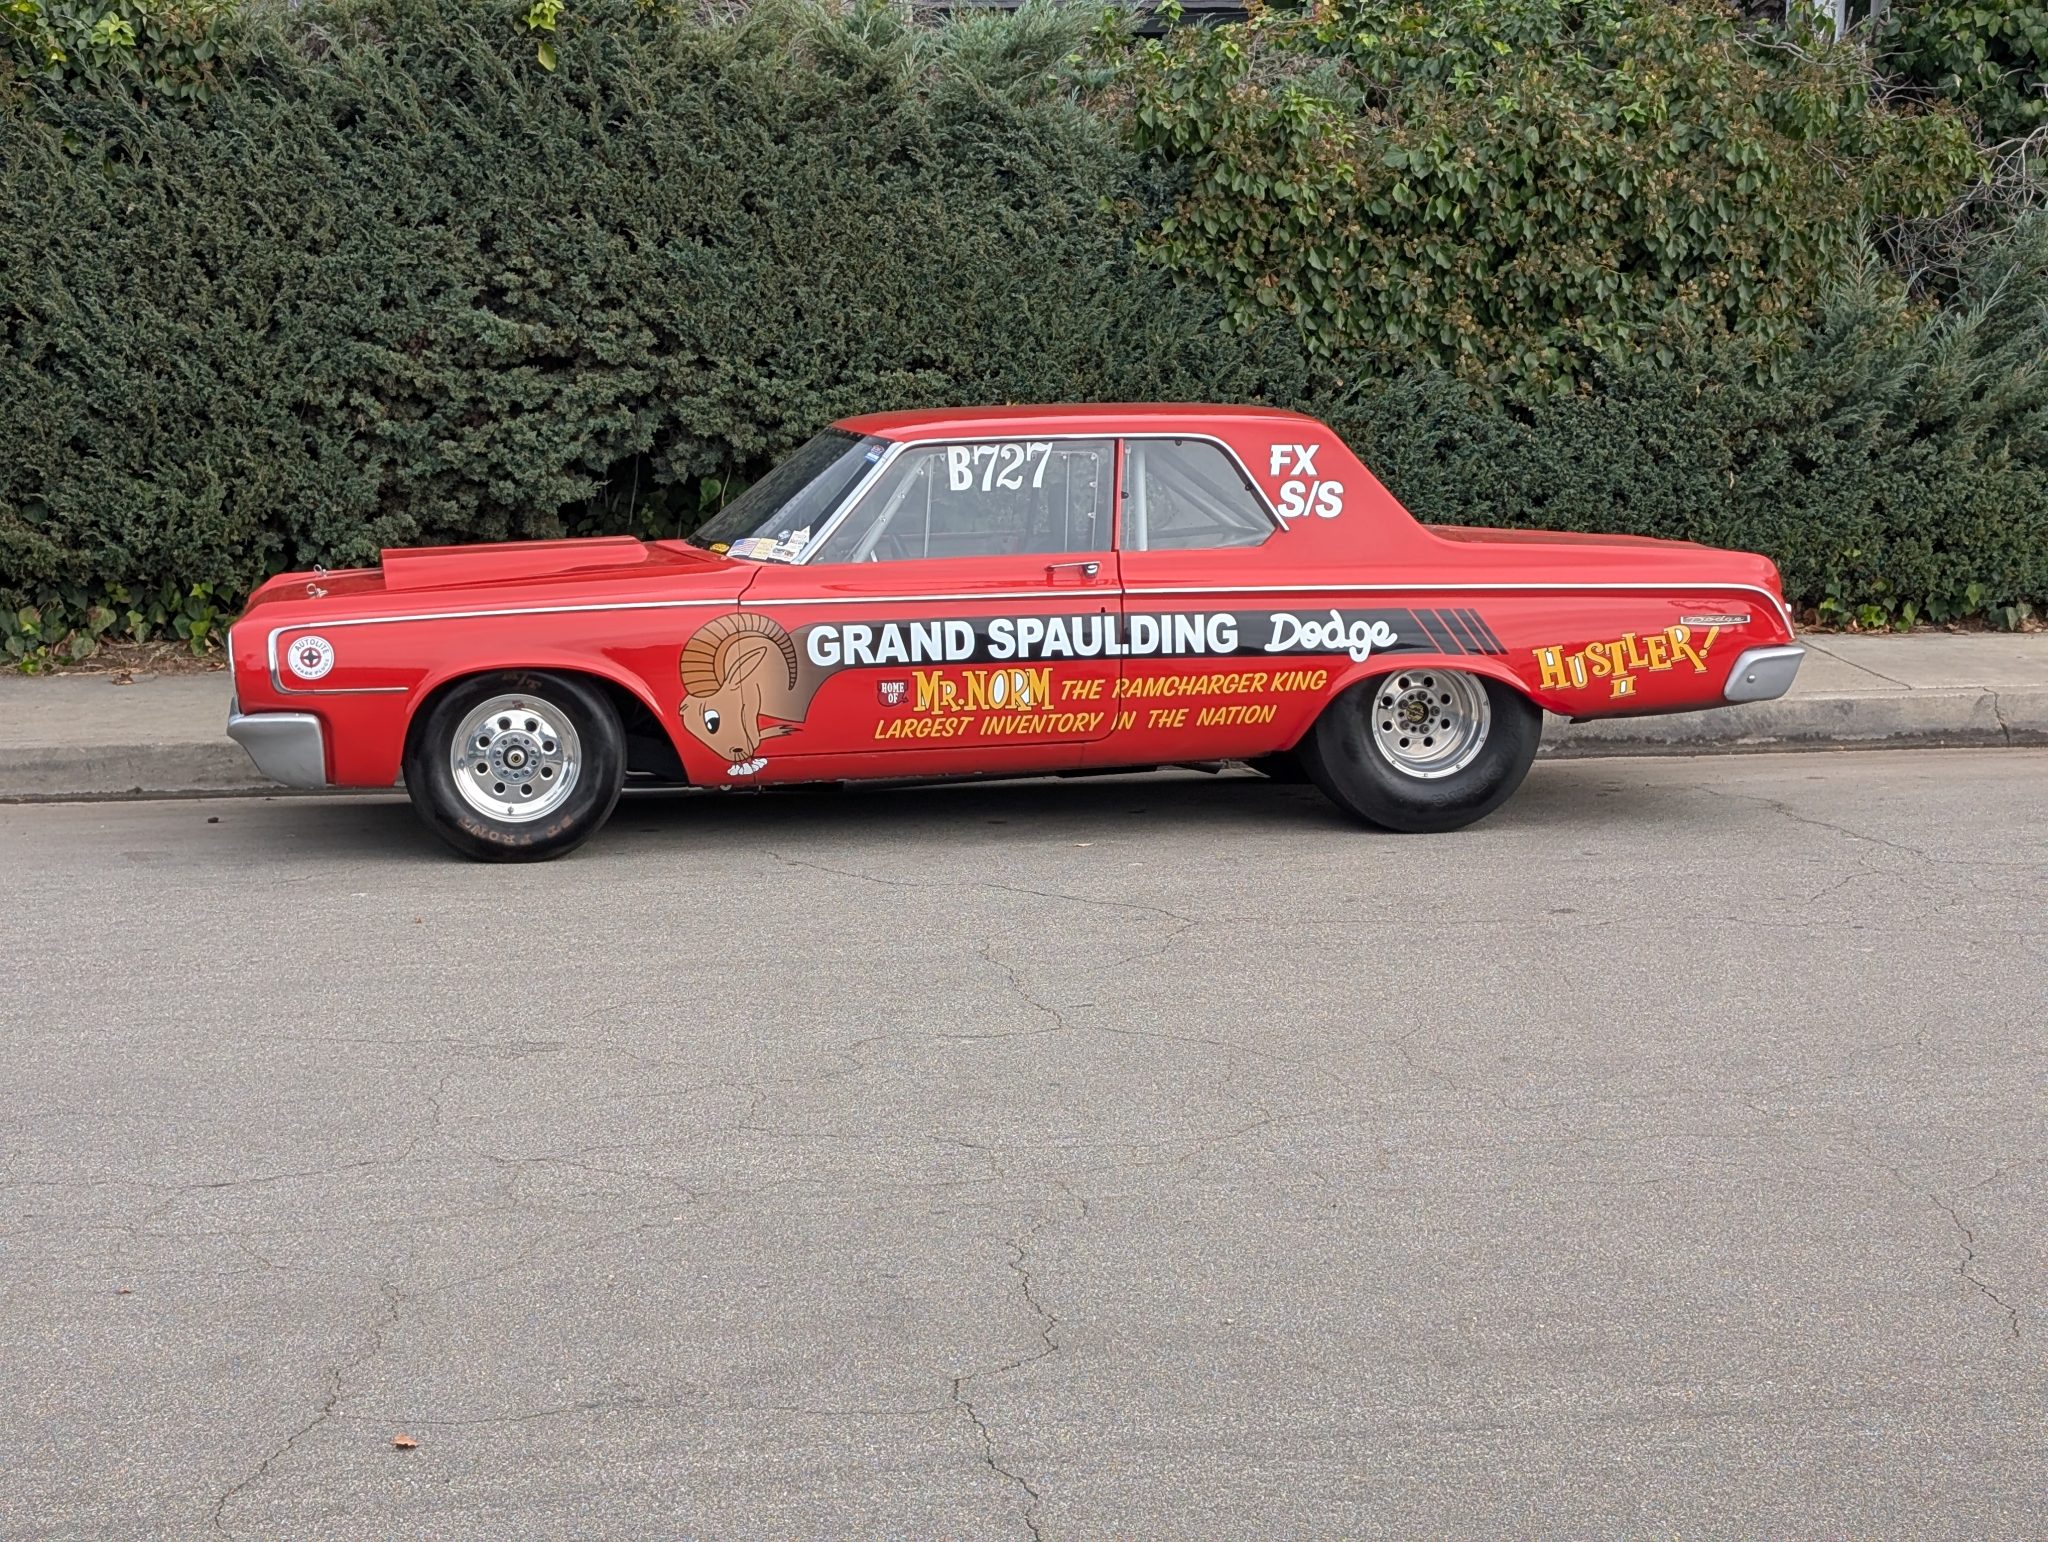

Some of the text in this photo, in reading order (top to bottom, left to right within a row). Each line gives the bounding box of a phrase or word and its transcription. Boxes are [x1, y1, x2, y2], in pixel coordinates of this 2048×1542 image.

[947, 442, 1053, 492] B727
[1270, 444, 1320, 476] FX
[1277, 480, 1344, 519] S/S
[1684, 614, 1745, 624] Dodge
[295, 638, 330, 655] AUTOLITE
[807, 609, 1398, 666] GRAND SPAULDING Dodge
[1532, 624, 1720, 691] HUSTLER!
[881, 682, 905, 694] HOME
[887, 692, 899, 704] OF
[1061, 679, 1105, 700] THE
[1111, 672, 1268, 699] RAMCHARGER
[1270, 670, 1327, 692] KING
[875, 705, 1277, 739] LARGEST INVENTORY IN THE NATION
